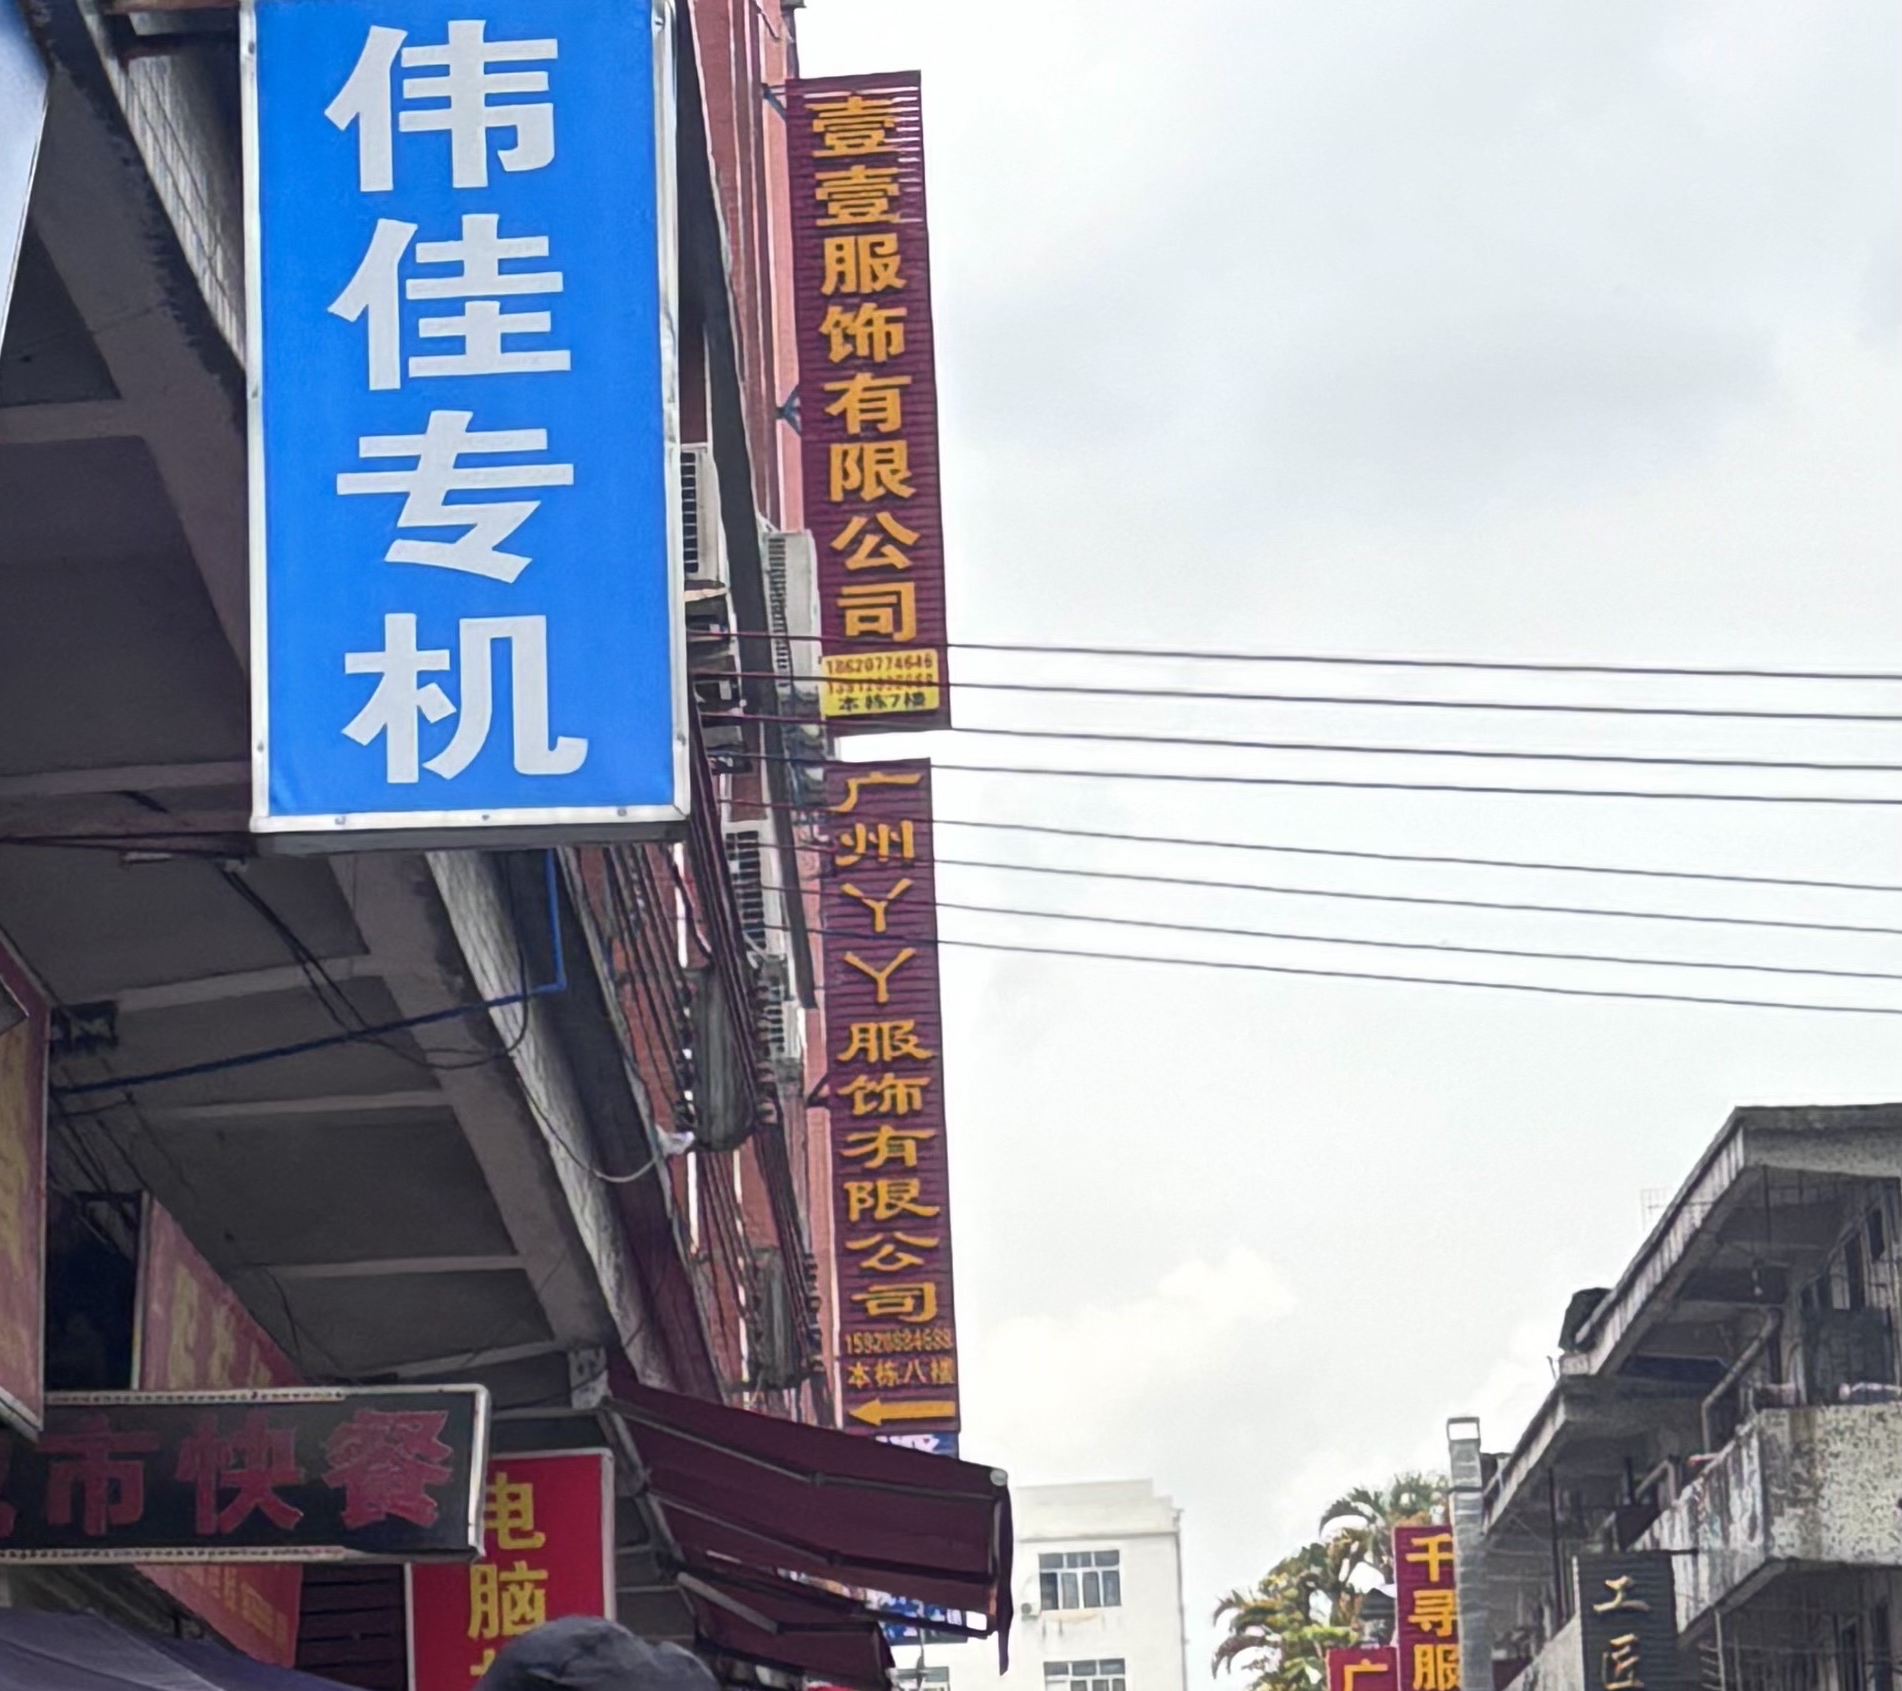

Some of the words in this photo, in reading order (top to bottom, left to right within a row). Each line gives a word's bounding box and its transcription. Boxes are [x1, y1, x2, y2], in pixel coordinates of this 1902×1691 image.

[324, 20, 587, 784] 伟佳专机
[808, 95, 921, 643] 壹壹服饰有限公司
[829, 771, 939, 1322] 广州丫丫服饰有限公司
[468, 1472, 548, 1676] 电脑
